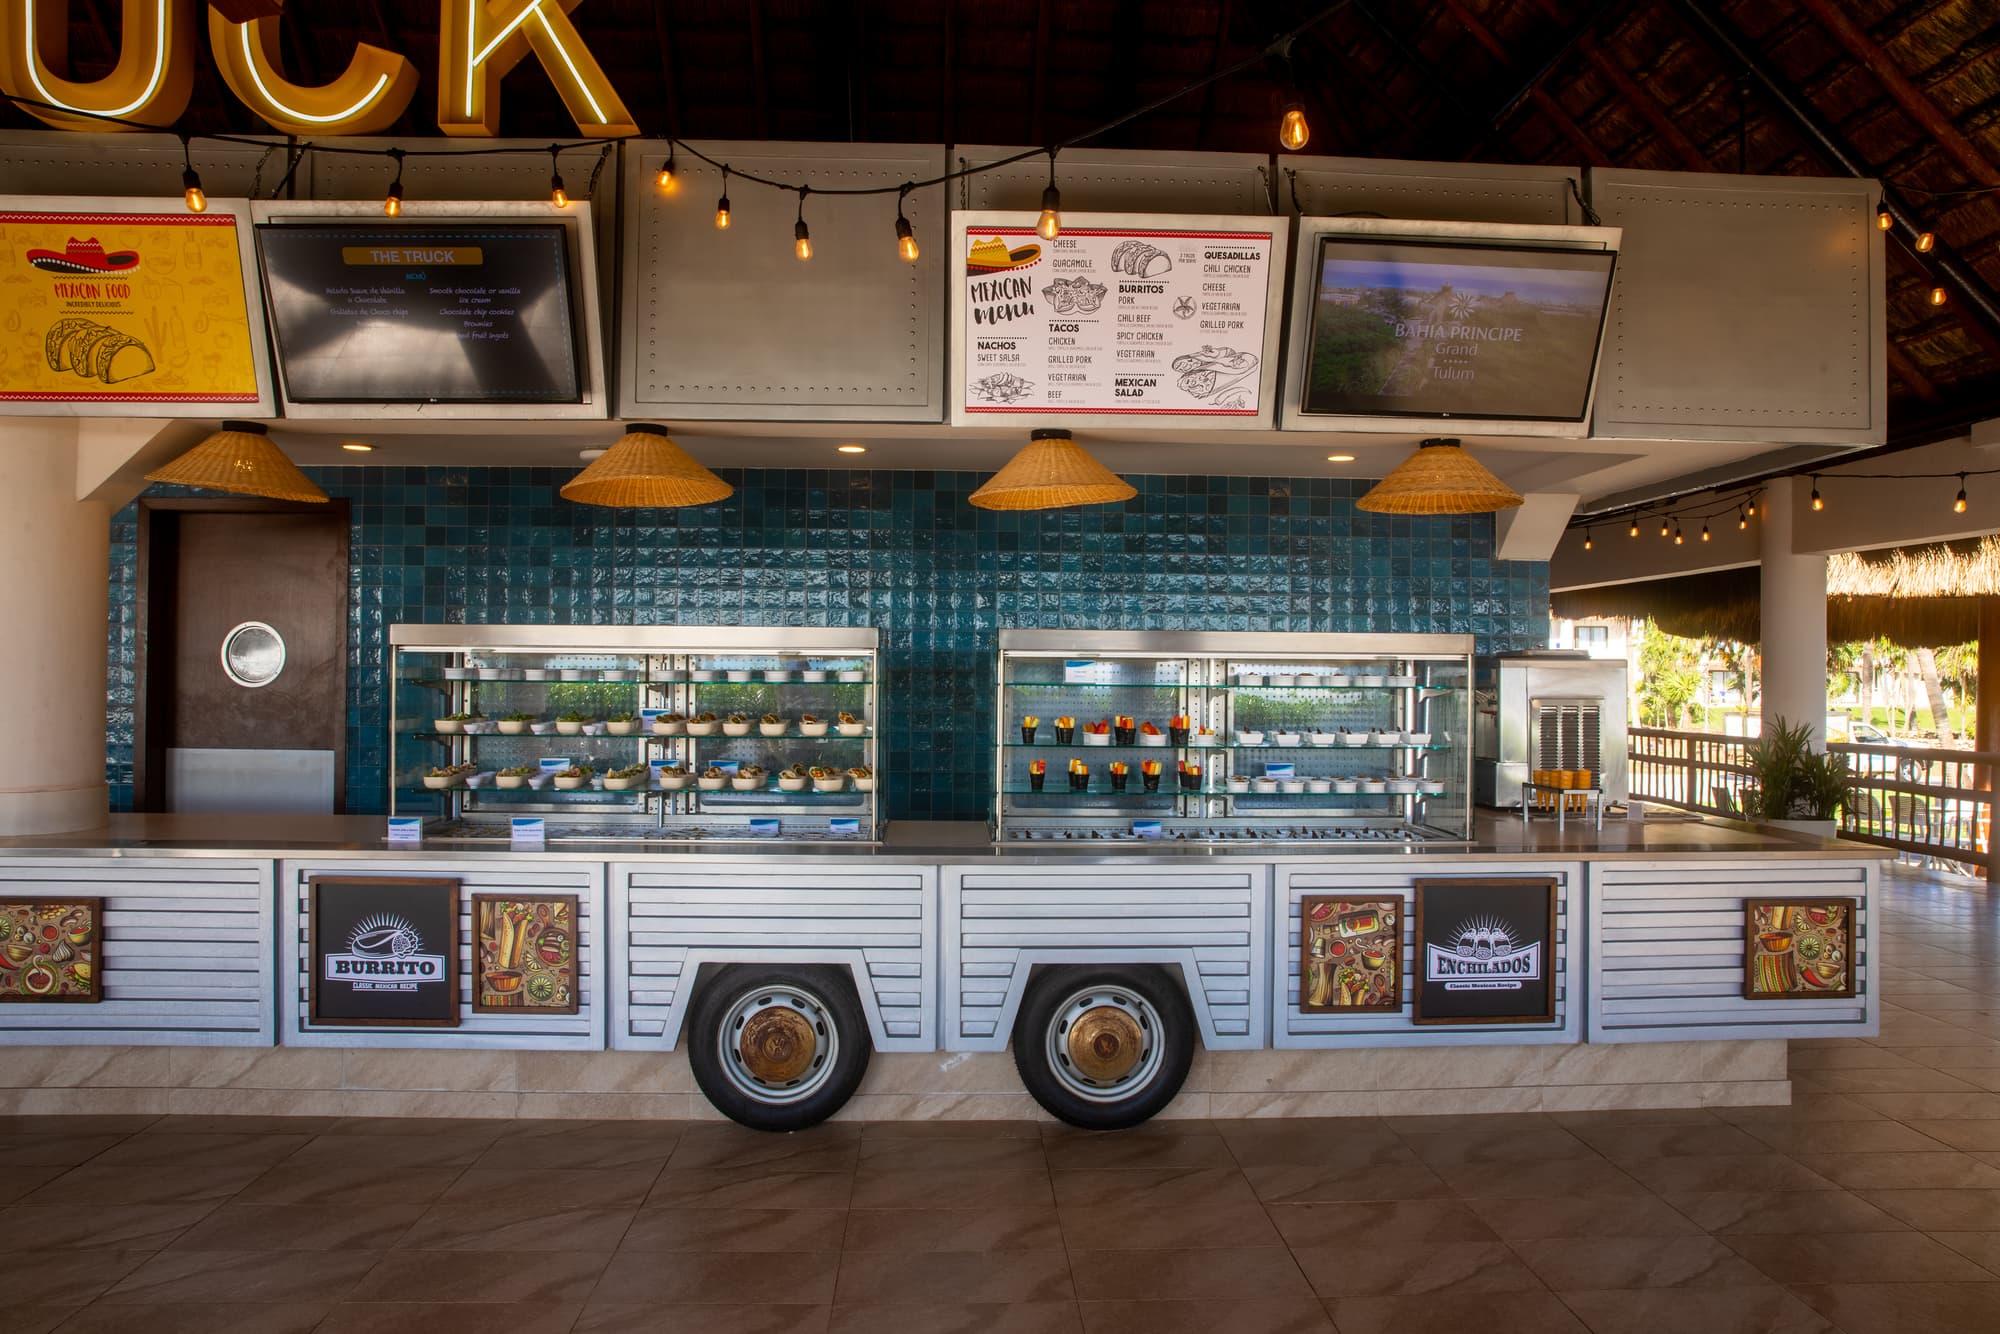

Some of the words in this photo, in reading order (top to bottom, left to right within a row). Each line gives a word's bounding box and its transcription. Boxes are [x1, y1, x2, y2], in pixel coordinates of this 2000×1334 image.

[1053, 239, 1076, 248] CHEESE
[370, 250, 400, 263] THE
[403, 250, 455, 263] TRUCK
[1204, 251, 1261, 261] QUESADILLAS
[1203, 264, 1221, 273] CHILI
[1223, 264, 1251, 273] CHICKEN
[54, 282, 101, 300] MEXICAN
[105, 283, 131, 299] FOOD
[970, 276, 1032, 303] MEXICAN
[1118, 284, 1164, 294] BURRITOS
[1202, 283, 1226, 292] CHEESE
[1118, 296, 1135, 305] PORK
[1201, 302, 1241, 311] VEGETARIAN
[974, 302, 1035, 325] menu
[1117, 314, 1135, 323] CHILI
[1136, 314, 1151, 322] BEEF
[1048, 323, 1080, 333] TACOS
[1199, 320, 1226, 329] GRILLED
[1227, 321, 1245, 329] PORK
[1116, 331, 1135, 340] SPICY
[1136, 332, 1164, 341] CHICKEN
[1394, 323, 1446, 338] BAHIA
[1450, 326, 1523, 342] PRINCIPE
[977, 341, 1017, 351] NACHOS
[1048, 337, 1076, 346] CHICKEN
[1116, 349, 1156, 359] VEGETARIAN
[1435, 342, 1478, 356] Grand
[977, 353, 997, 362] SWEET
[999, 353, 1021, 362] SALSA
[1047, 355, 1074, 365] GRILLED
[1075, 356, 1093, 365] PORK
[1047, 373, 1087, 382] VEGETARIAN
[1433, 366, 1475, 380] Tulum
[1114, 378, 1157, 388] MEXICAN
[1047, 390, 1063, 399] BEEF
[1114, 388, 1144, 397] SALAD
[335, 960, 435, 975] BURRITO
[1437, 953, 1531, 975] ENCHILADOS
[352, 981, 374, 989] CLASSIC
